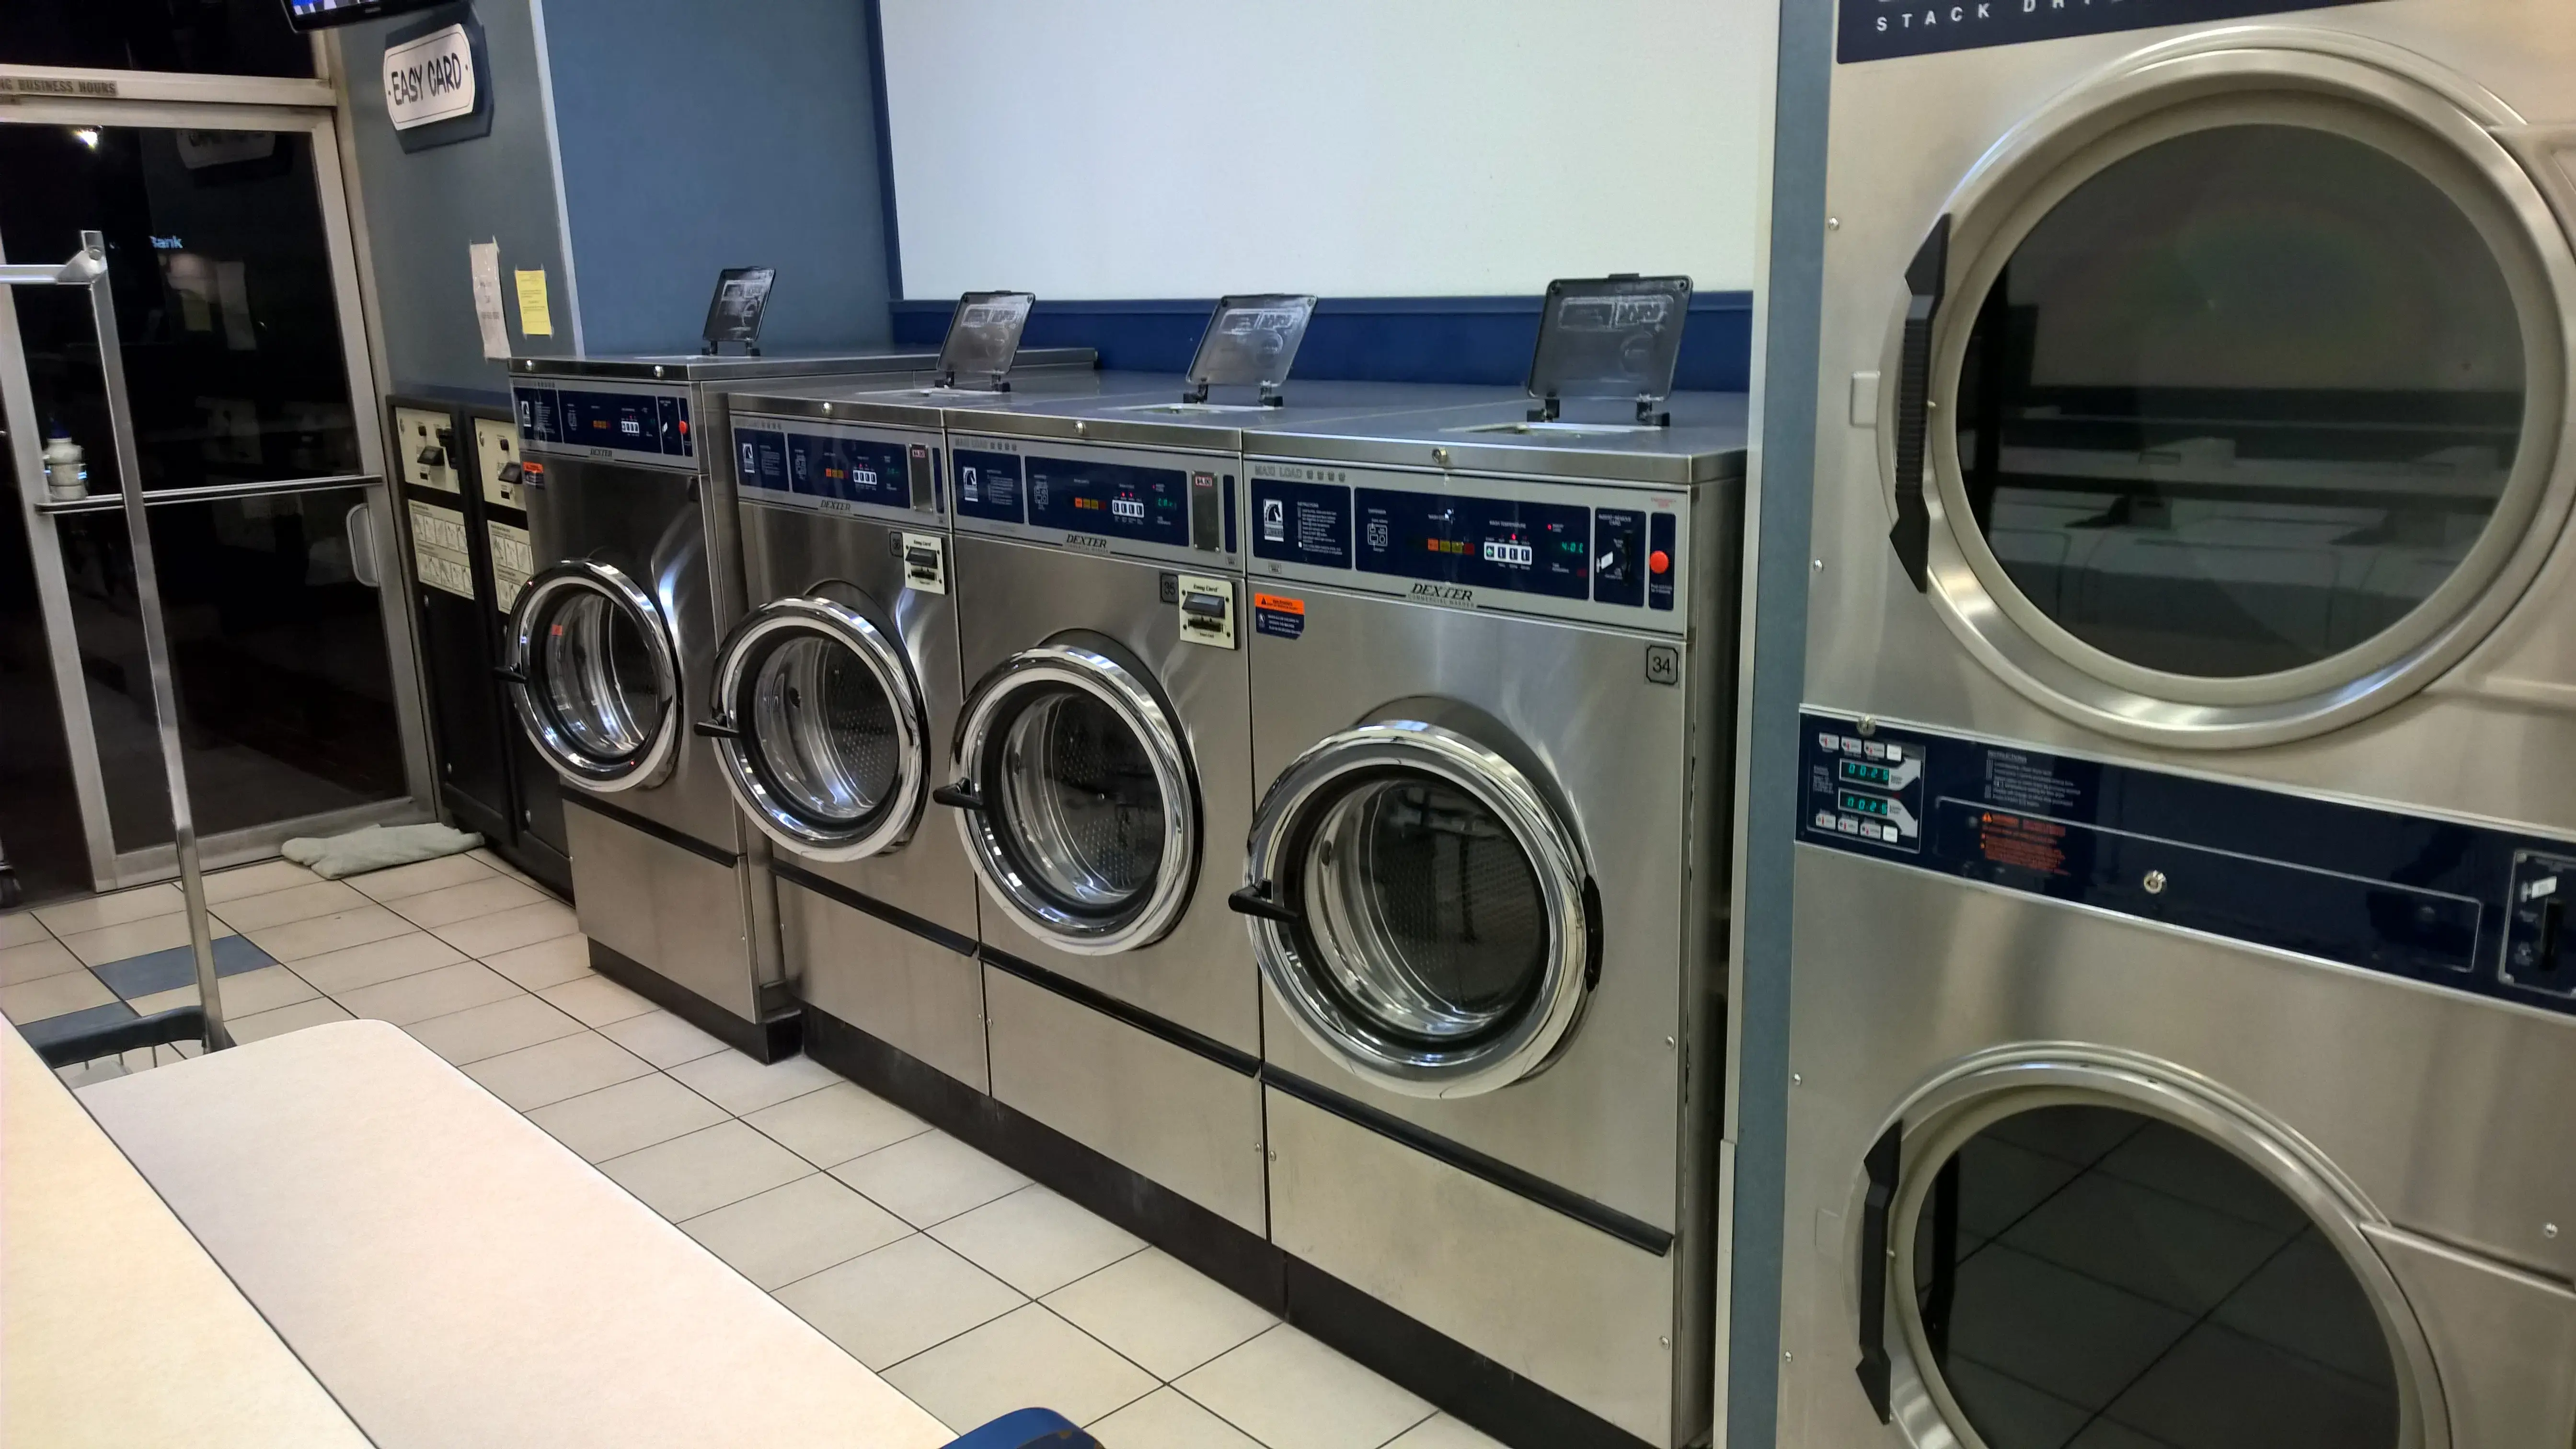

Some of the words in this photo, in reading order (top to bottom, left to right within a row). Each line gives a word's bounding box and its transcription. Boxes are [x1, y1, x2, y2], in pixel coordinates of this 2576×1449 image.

[1876, 3, 1990, 32] STACK
[18, 80, 73, 92] BUSINESS
[79, 81, 116, 94] HOURS
[391, 64, 425, 106] EASY
[428, 53, 461, 97] CARD
[820, 500, 851, 512] DEXTER
[1066, 533, 1106, 548] DEXTER
[1411, 583, 1472, 600] DEXTER
[1653, 656, 1671, 674] 34
